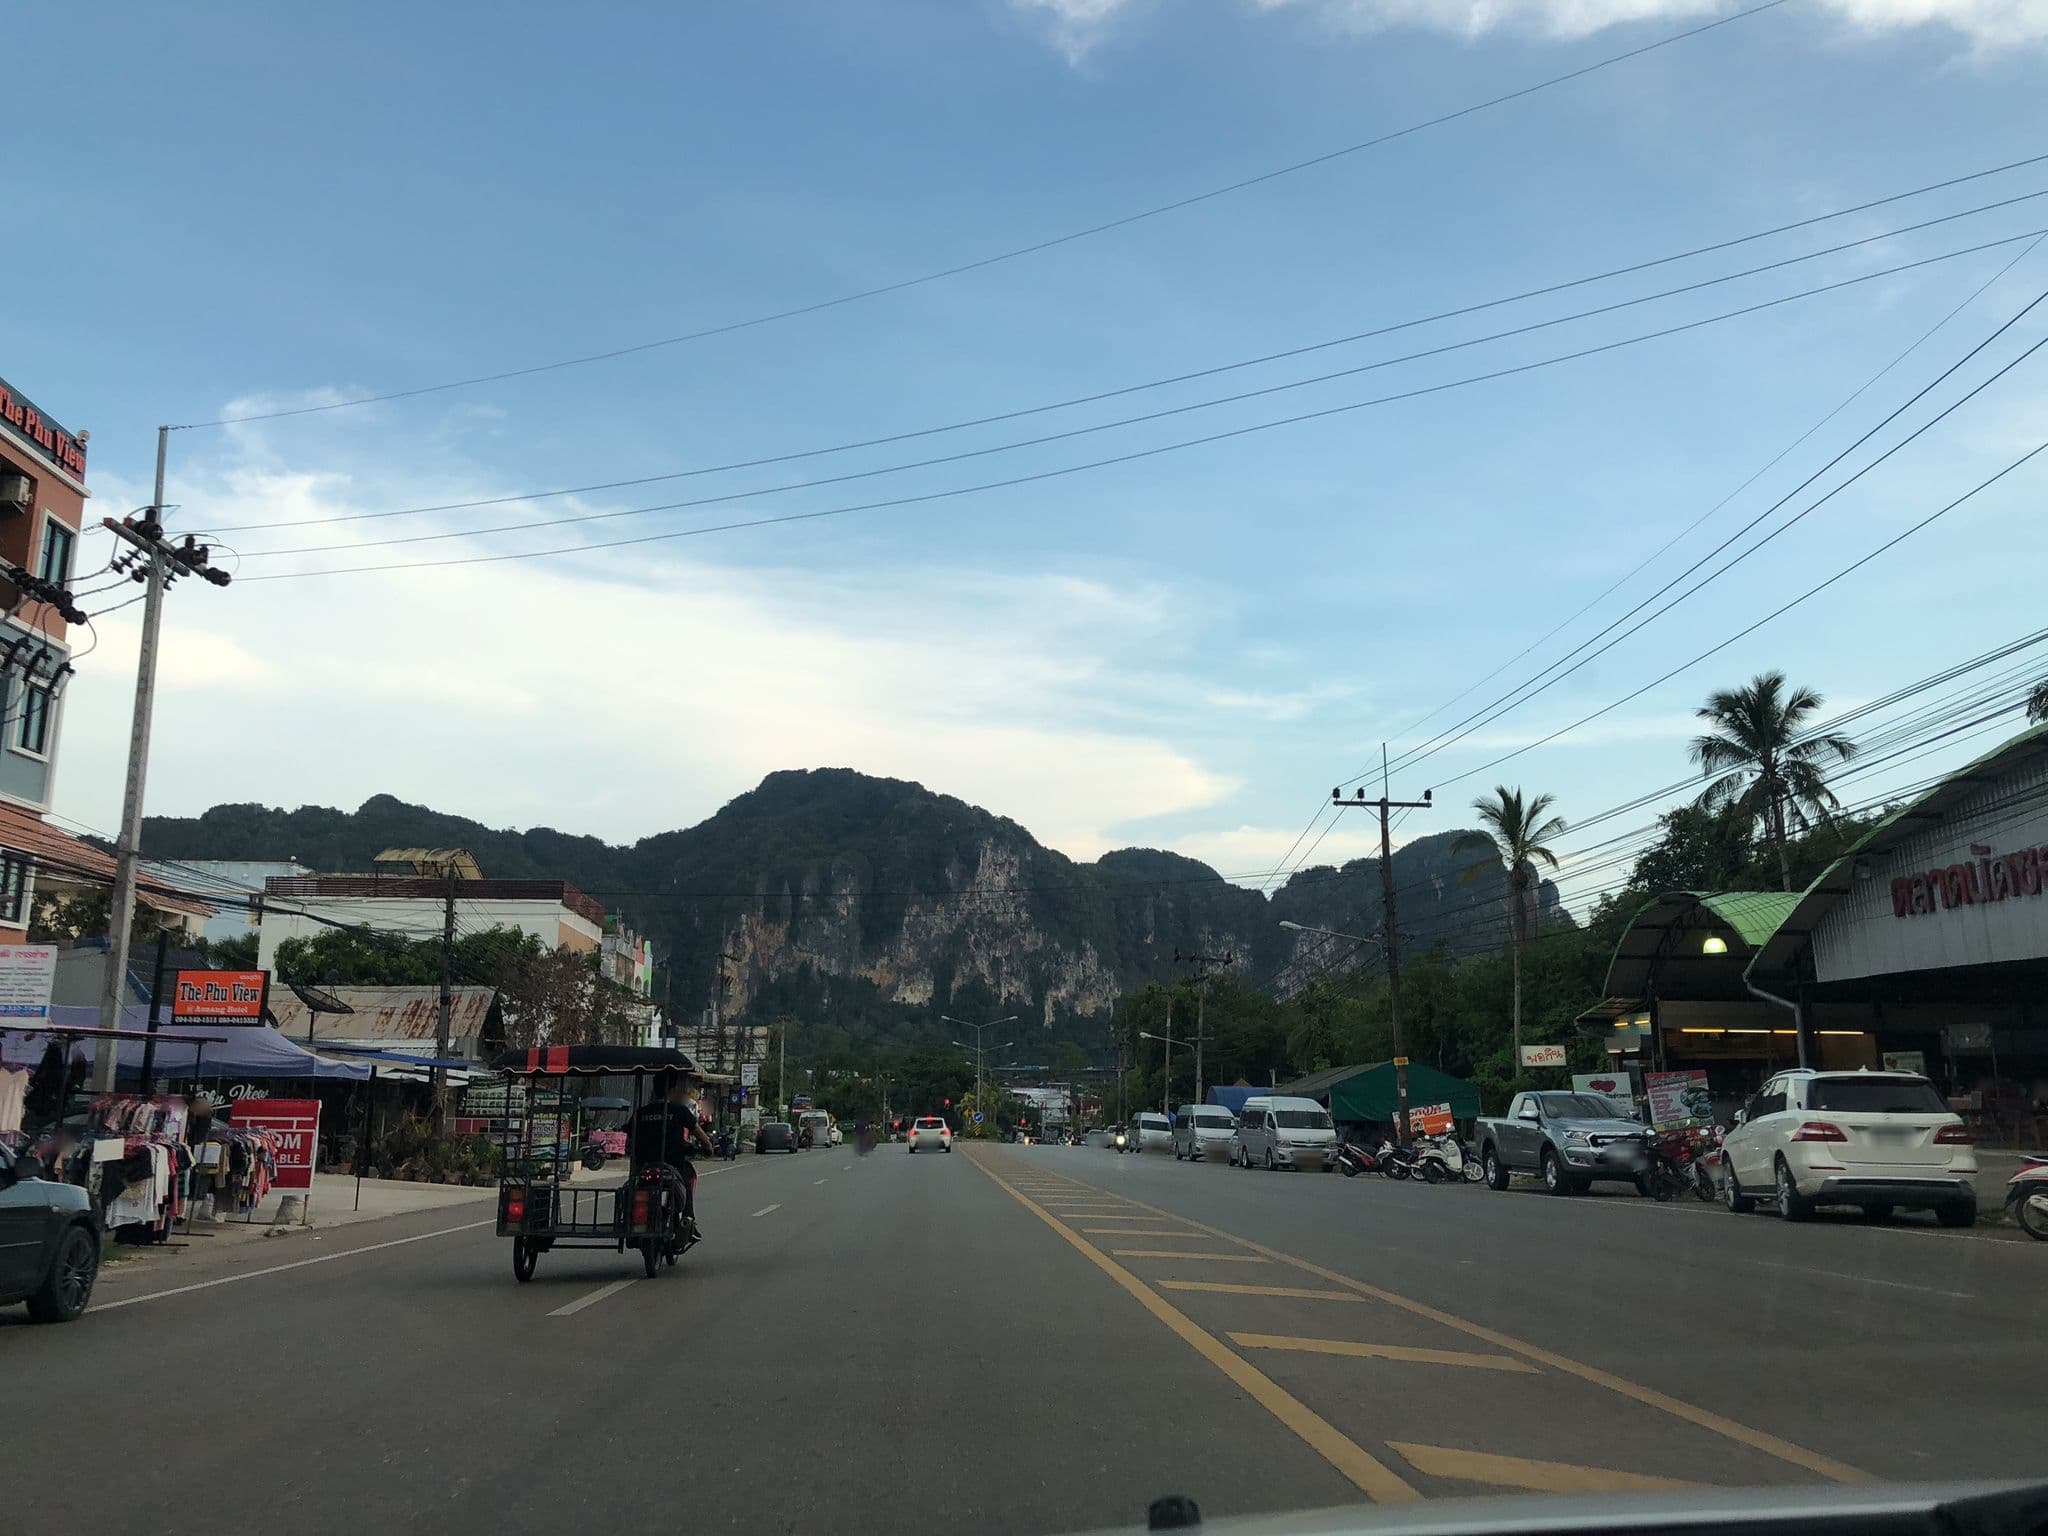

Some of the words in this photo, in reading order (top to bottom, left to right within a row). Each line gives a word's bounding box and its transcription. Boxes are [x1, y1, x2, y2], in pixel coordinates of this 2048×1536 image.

[25, 407, 53, 450] Phu
[56, 431, 85, 473] View
[180, 981, 203, 1002] The
[204, 981, 229, 1002] Phu
[232, 982, 260, 1003] View
[228, 1083, 269, 1101] View
